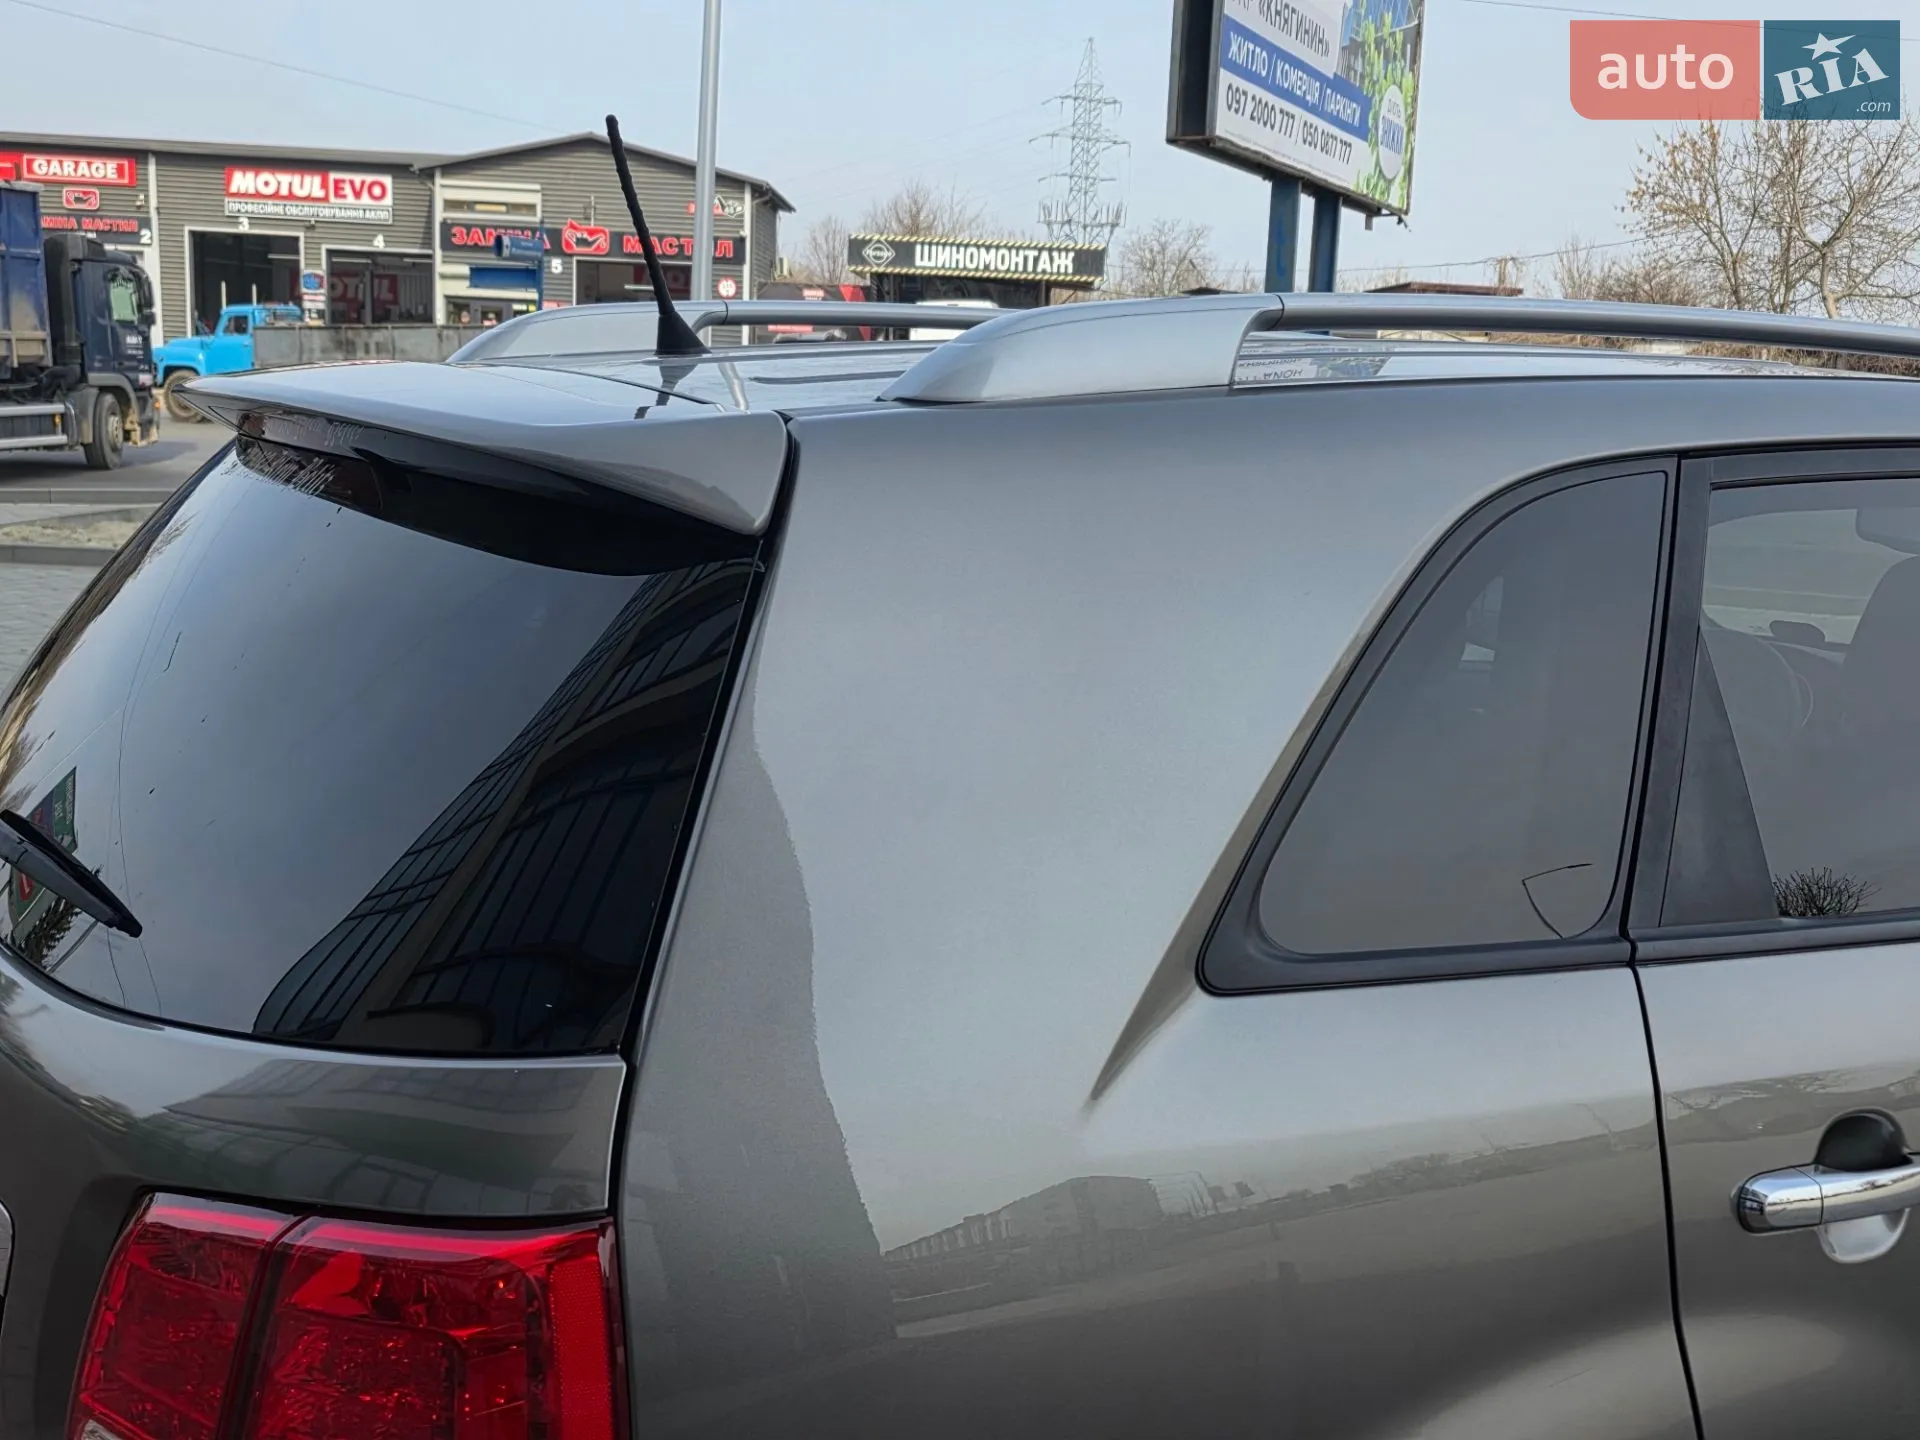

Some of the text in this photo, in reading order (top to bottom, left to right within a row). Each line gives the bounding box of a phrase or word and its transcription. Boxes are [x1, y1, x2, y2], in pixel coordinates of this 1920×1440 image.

[1228, 31, 1268, 77] ЖИТЛО
[1276, 58, 1321, 107] КОМЕРЦІЯ
[1226, 82, 1248, 117] 097
[1249, 93, 1277, 130] 2000
[1278, 109, 1296, 139] 777
[1302, 120, 1319, 150] 050
[1339, 138, 1353, 165] 777
[32, 159, 118, 179] GARAGE
[230, 170, 388, 202] MOTUL EVO
[238, 217, 250, 231] 3
[140, 229, 152, 244] 2
[372, 234, 385, 249] 4
[551, 259, 563, 274] 5
[914, 243, 1075, 275] ШИНОМОНТАЖ
